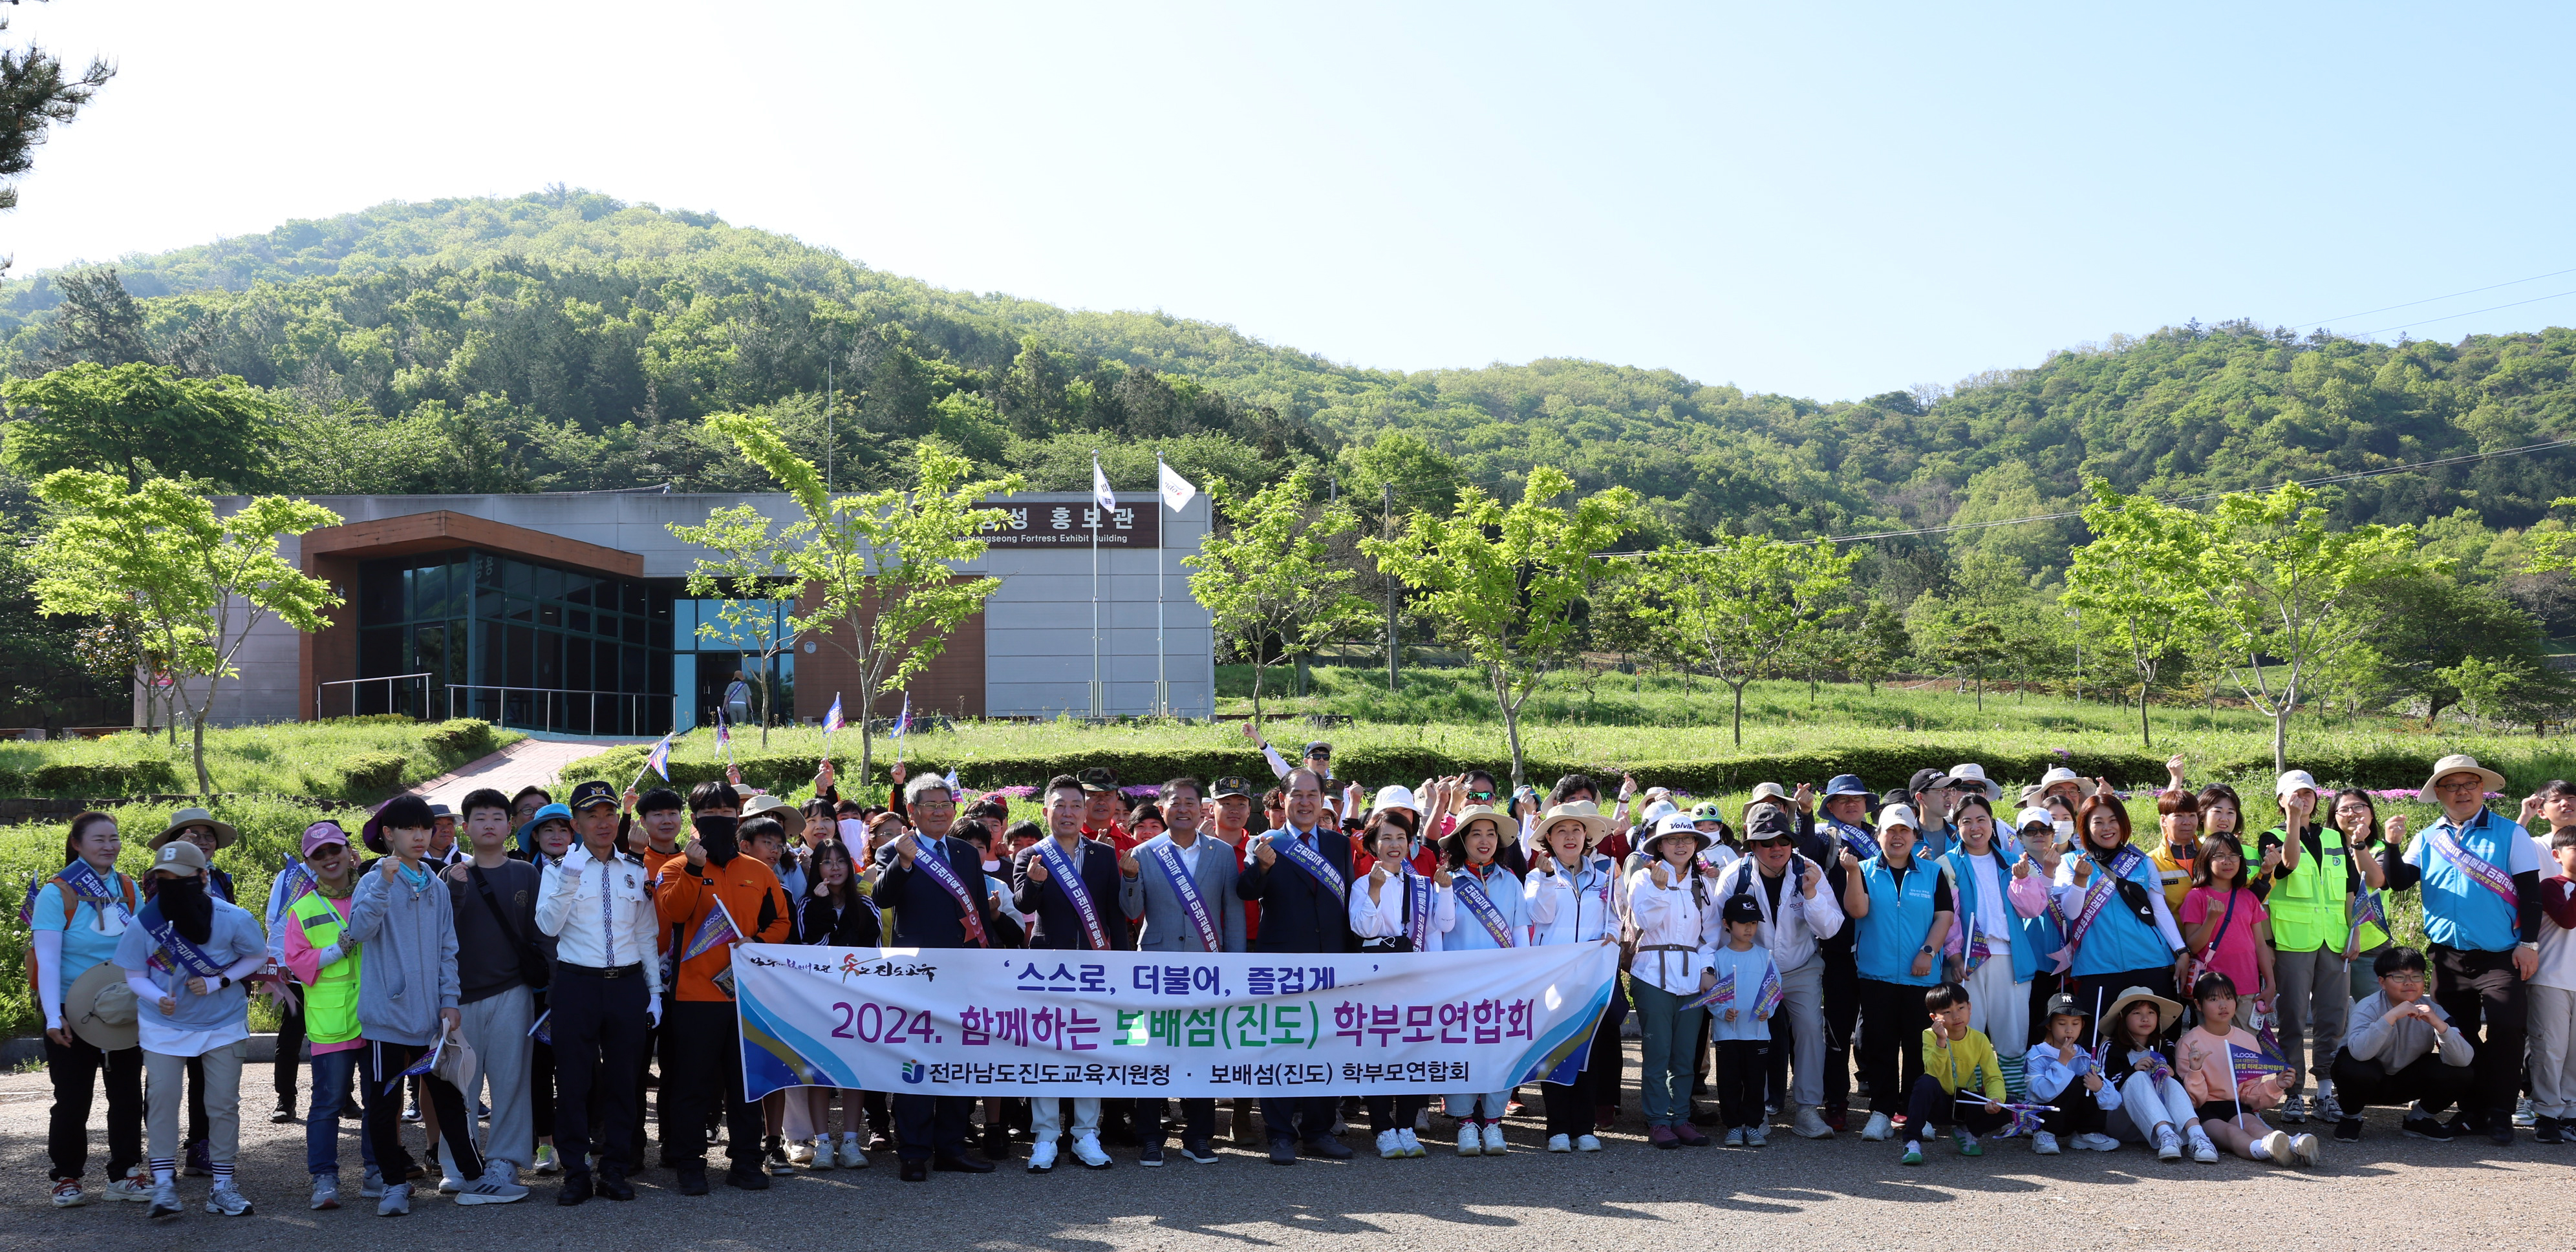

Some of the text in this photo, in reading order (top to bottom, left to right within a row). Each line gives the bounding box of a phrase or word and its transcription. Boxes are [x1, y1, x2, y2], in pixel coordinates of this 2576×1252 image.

[163, 847, 177, 861] B
[1843, 824, 1871, 844] 대한민국
[1158, 845, 1182, 876] 대한민국
[1175, 875, 1197, 902] 글로컬
[1294, 843, 1325, 866] 대한민국
[1321, 862, 1341, 884] 글로컬
[2460, 853, 2489, 873] 글로컬
[928, 860, 974, 913] 미래교육박람회
[1038, 838, 1105, 949] 대한민국 글로컬 미래교육박람회
[1417, 891, 1426, 915] 글로컬
[1465, 884, 1492, 911] 대한민국
[1486, 907, 1507, 931] 글로컬
[2073, 893, 2107, 941] 미래교육박람회
[1133, 964, 1231, 997] 더불어,
[831, 997, 1534, 1051] 2024. 함께하는 보배섬(진도) 학부모연합회
[928, 1061, 1170, 1086] 전라남도진도교육지원청
[1209, 1061, 1334, 1086] 보배섬(진도)
[1342, 1060, 1470, 1083] 학부모연합회
